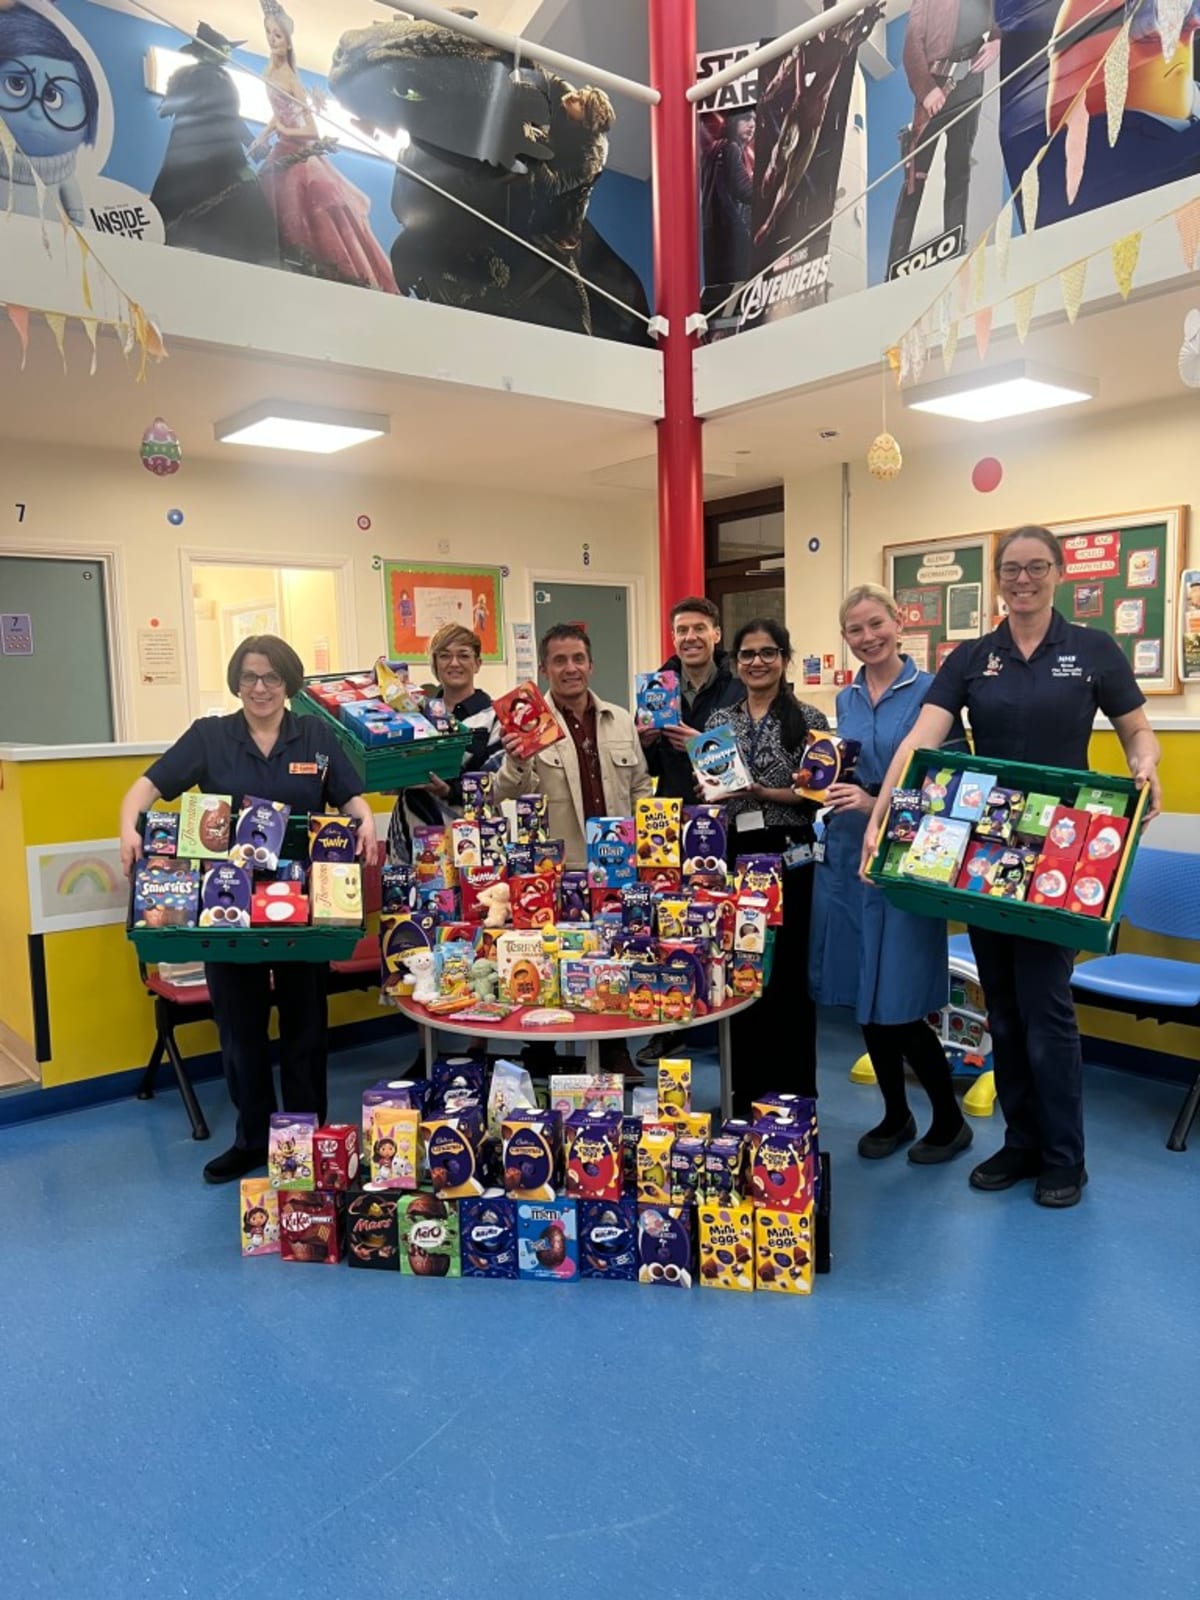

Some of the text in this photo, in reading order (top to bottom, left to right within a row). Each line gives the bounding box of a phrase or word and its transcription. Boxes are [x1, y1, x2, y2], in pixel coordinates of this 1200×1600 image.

[90, 207, 150, 234] INSIDE
[897, 235, 956, 276] SOLO
[741, 254, 832, 326] AVENGERS
[15, 504, 25, 523] 7
[318, 836, 349, 849] Twirl
[353, 1218, 393, 1232] Mars
[709, 1223, 736, 1236] Mini
[767, 1226, 794, 1238] Mini
[710, 1234, 740, 1246] eggs
[768, 1236, 798, 1248] eggs
